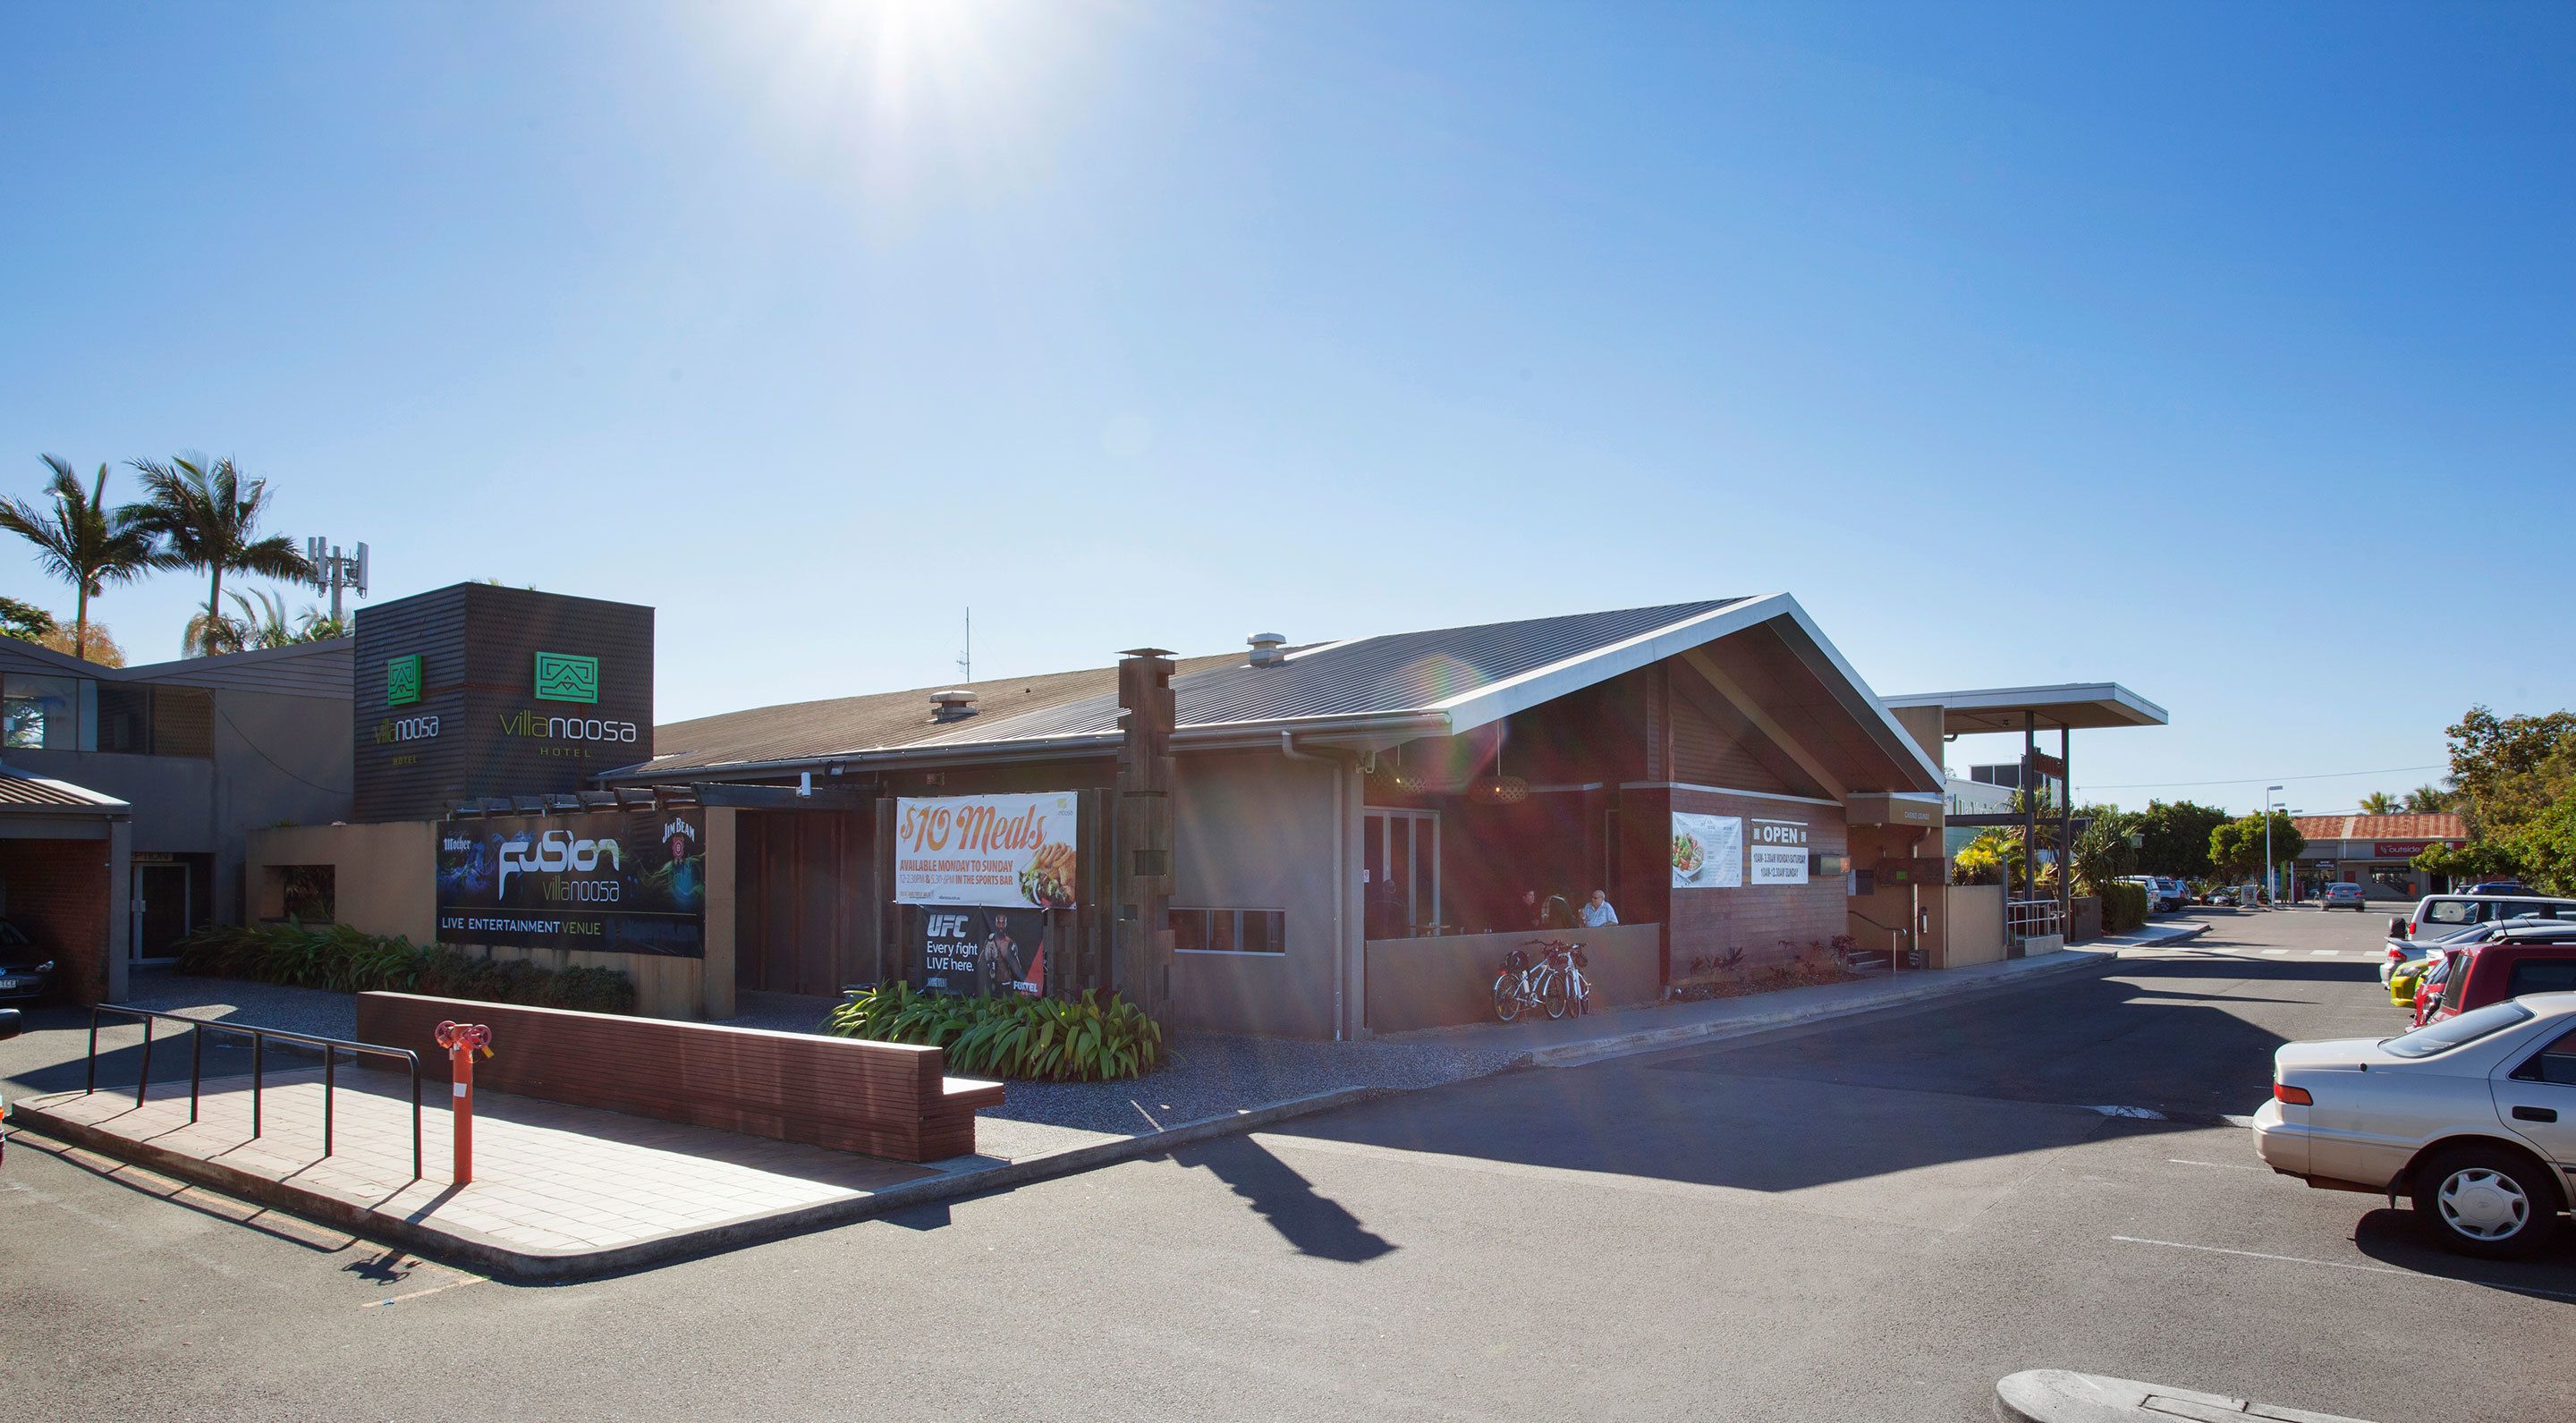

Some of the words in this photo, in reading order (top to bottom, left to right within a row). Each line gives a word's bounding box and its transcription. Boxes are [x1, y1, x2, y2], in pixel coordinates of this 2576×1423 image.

[499, 710, 636, 742] villanoosa
[393, 755, 418, 766] HOTEL
[539, 747, 592, 758] HOTEL
[662, 822, 675, 843] JIM
[675, 817, 695, 843] BEAM
[900, 804, 951, 853] $10
[956, 804, 1047, 855] Meals
[1763, 826, 1798, 843] OPEN
[444, 837, 471, 851] Mother
[899, 860, 936, 872] AVAILABLE
[937, 860, 970, 872] MONDAY
[971, 860, 981, 872] TO
[982, 860, 1013, 872] SUNDAY
[925, 874, 930, 884] &
[955, 875, 962, 884] IN
[963, 875, 974, 885] THE
[975, 875, 999, 885] SPORTS
[999, 876, 1013, 885] BAR
[543, 876, 620, 902] villanoosa
[442, 918, 464, 929] LIVE
[469, 919, 560, 934] ENTERTAINMENT
[562, 921, 601, 936] VENUE
[927, 915, 969, 937] UFC
[927, 941, 953, 957] Every
[955, 942, 978, 958] fight
[927, 957, 949, 970] LIVE
[951, 958, 974, 972] here.
[1013, 980, 1038, 993] FOXTEL
